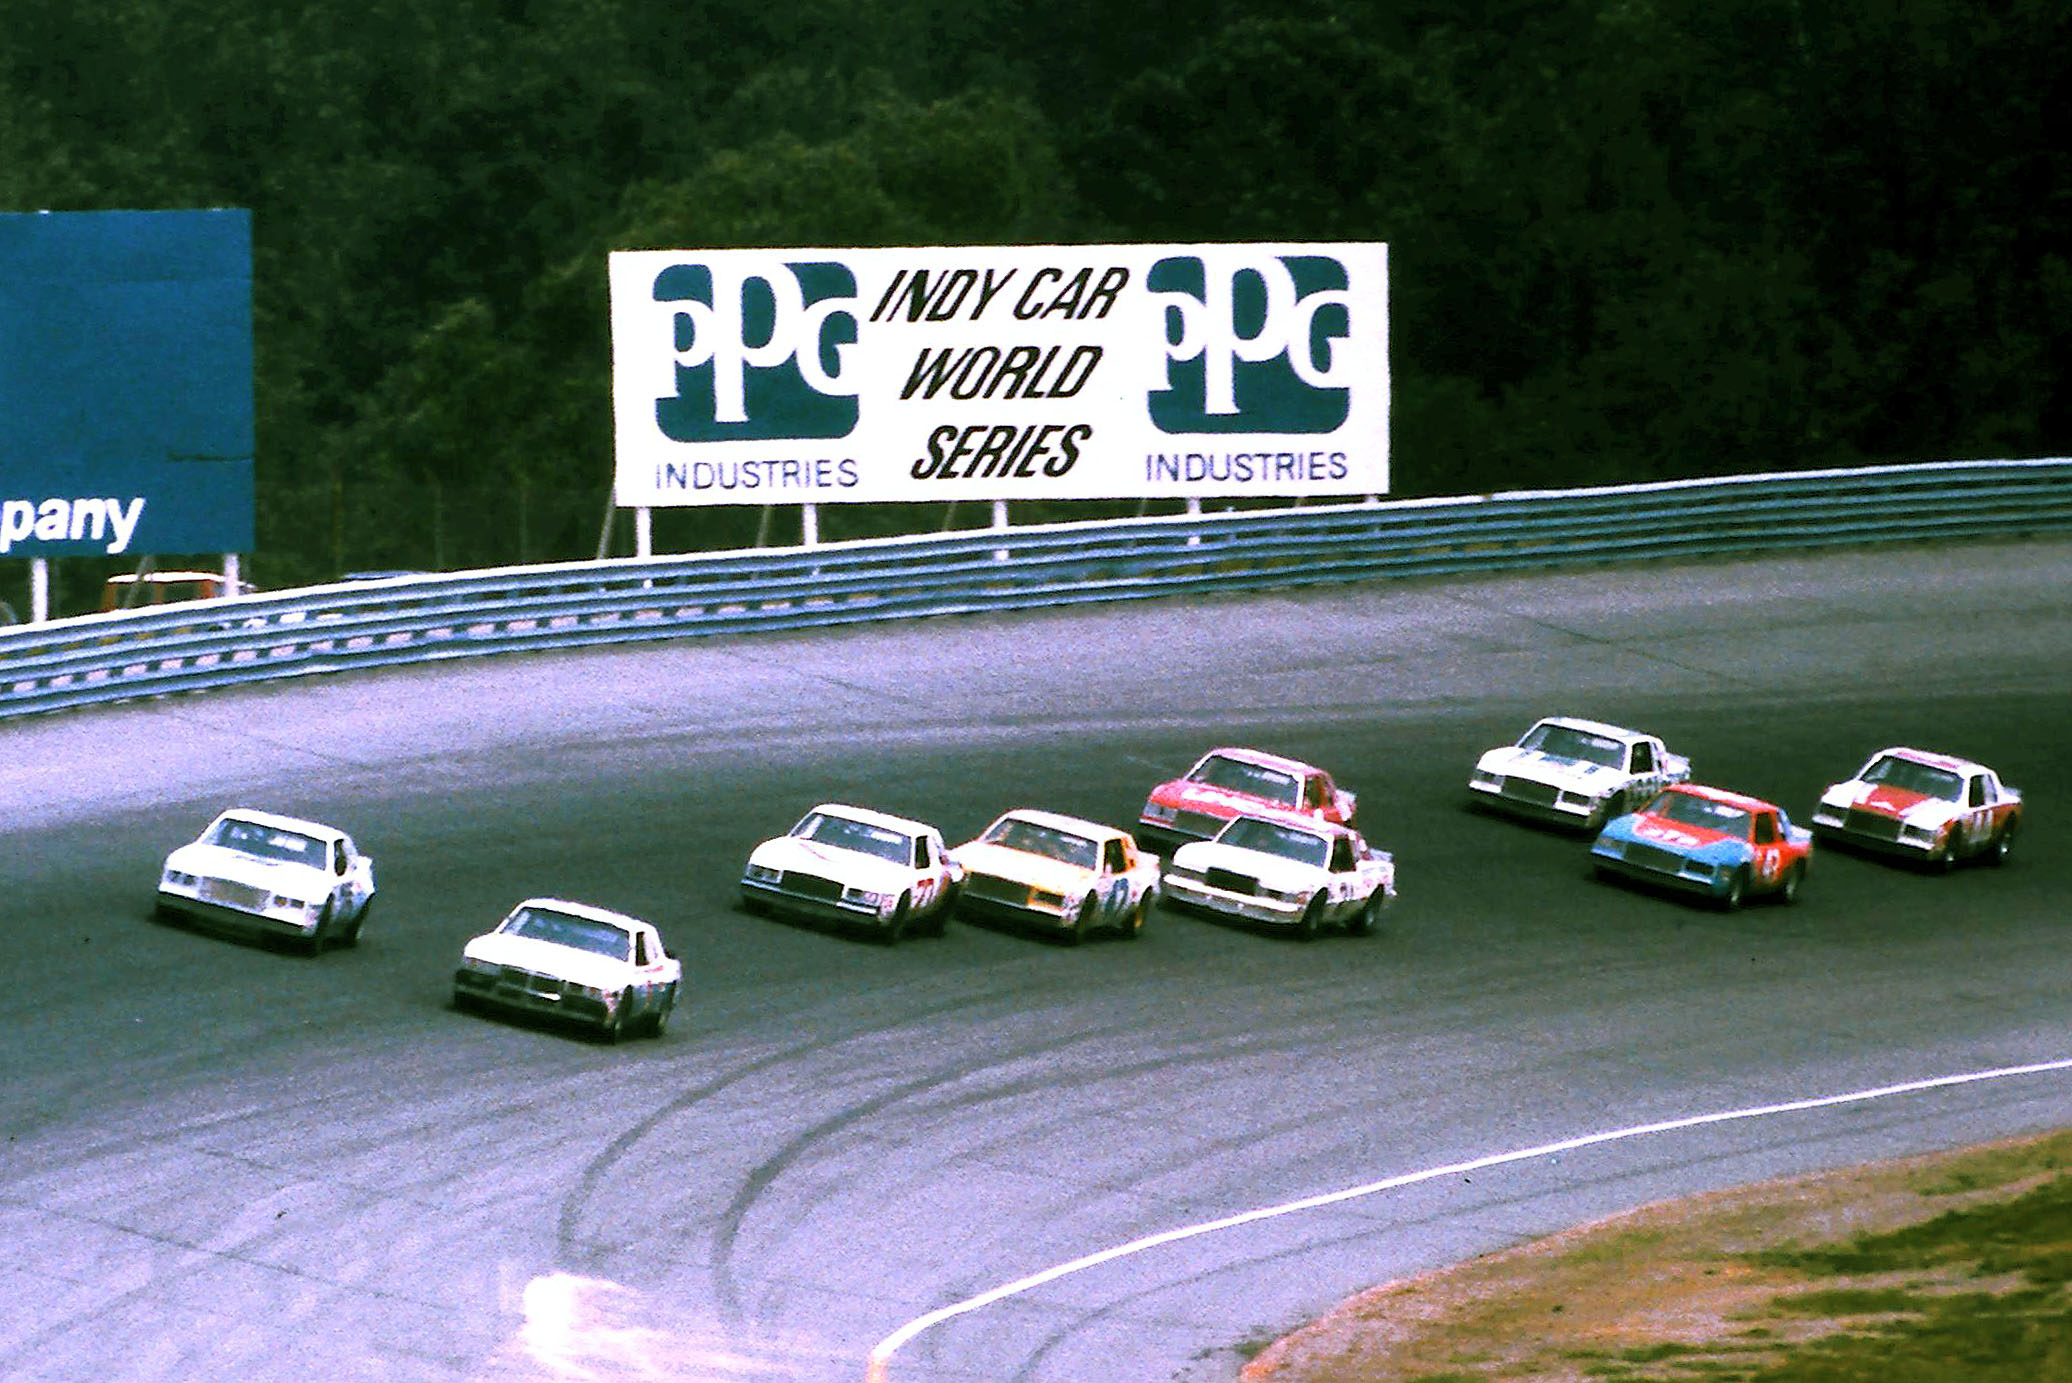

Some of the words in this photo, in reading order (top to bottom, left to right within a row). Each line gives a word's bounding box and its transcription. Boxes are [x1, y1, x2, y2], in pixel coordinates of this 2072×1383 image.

[868, 268, 1019, 323] INDY
[1013, 267, 1131, 321] CAR
[900, 345, 1104, 401] WORLD
[656, 458, 859, 490] INDUSTRIES
[909, 423, 1093, 481] SERIES
[1146, 451, 1348, 483] INDUSTRIES
